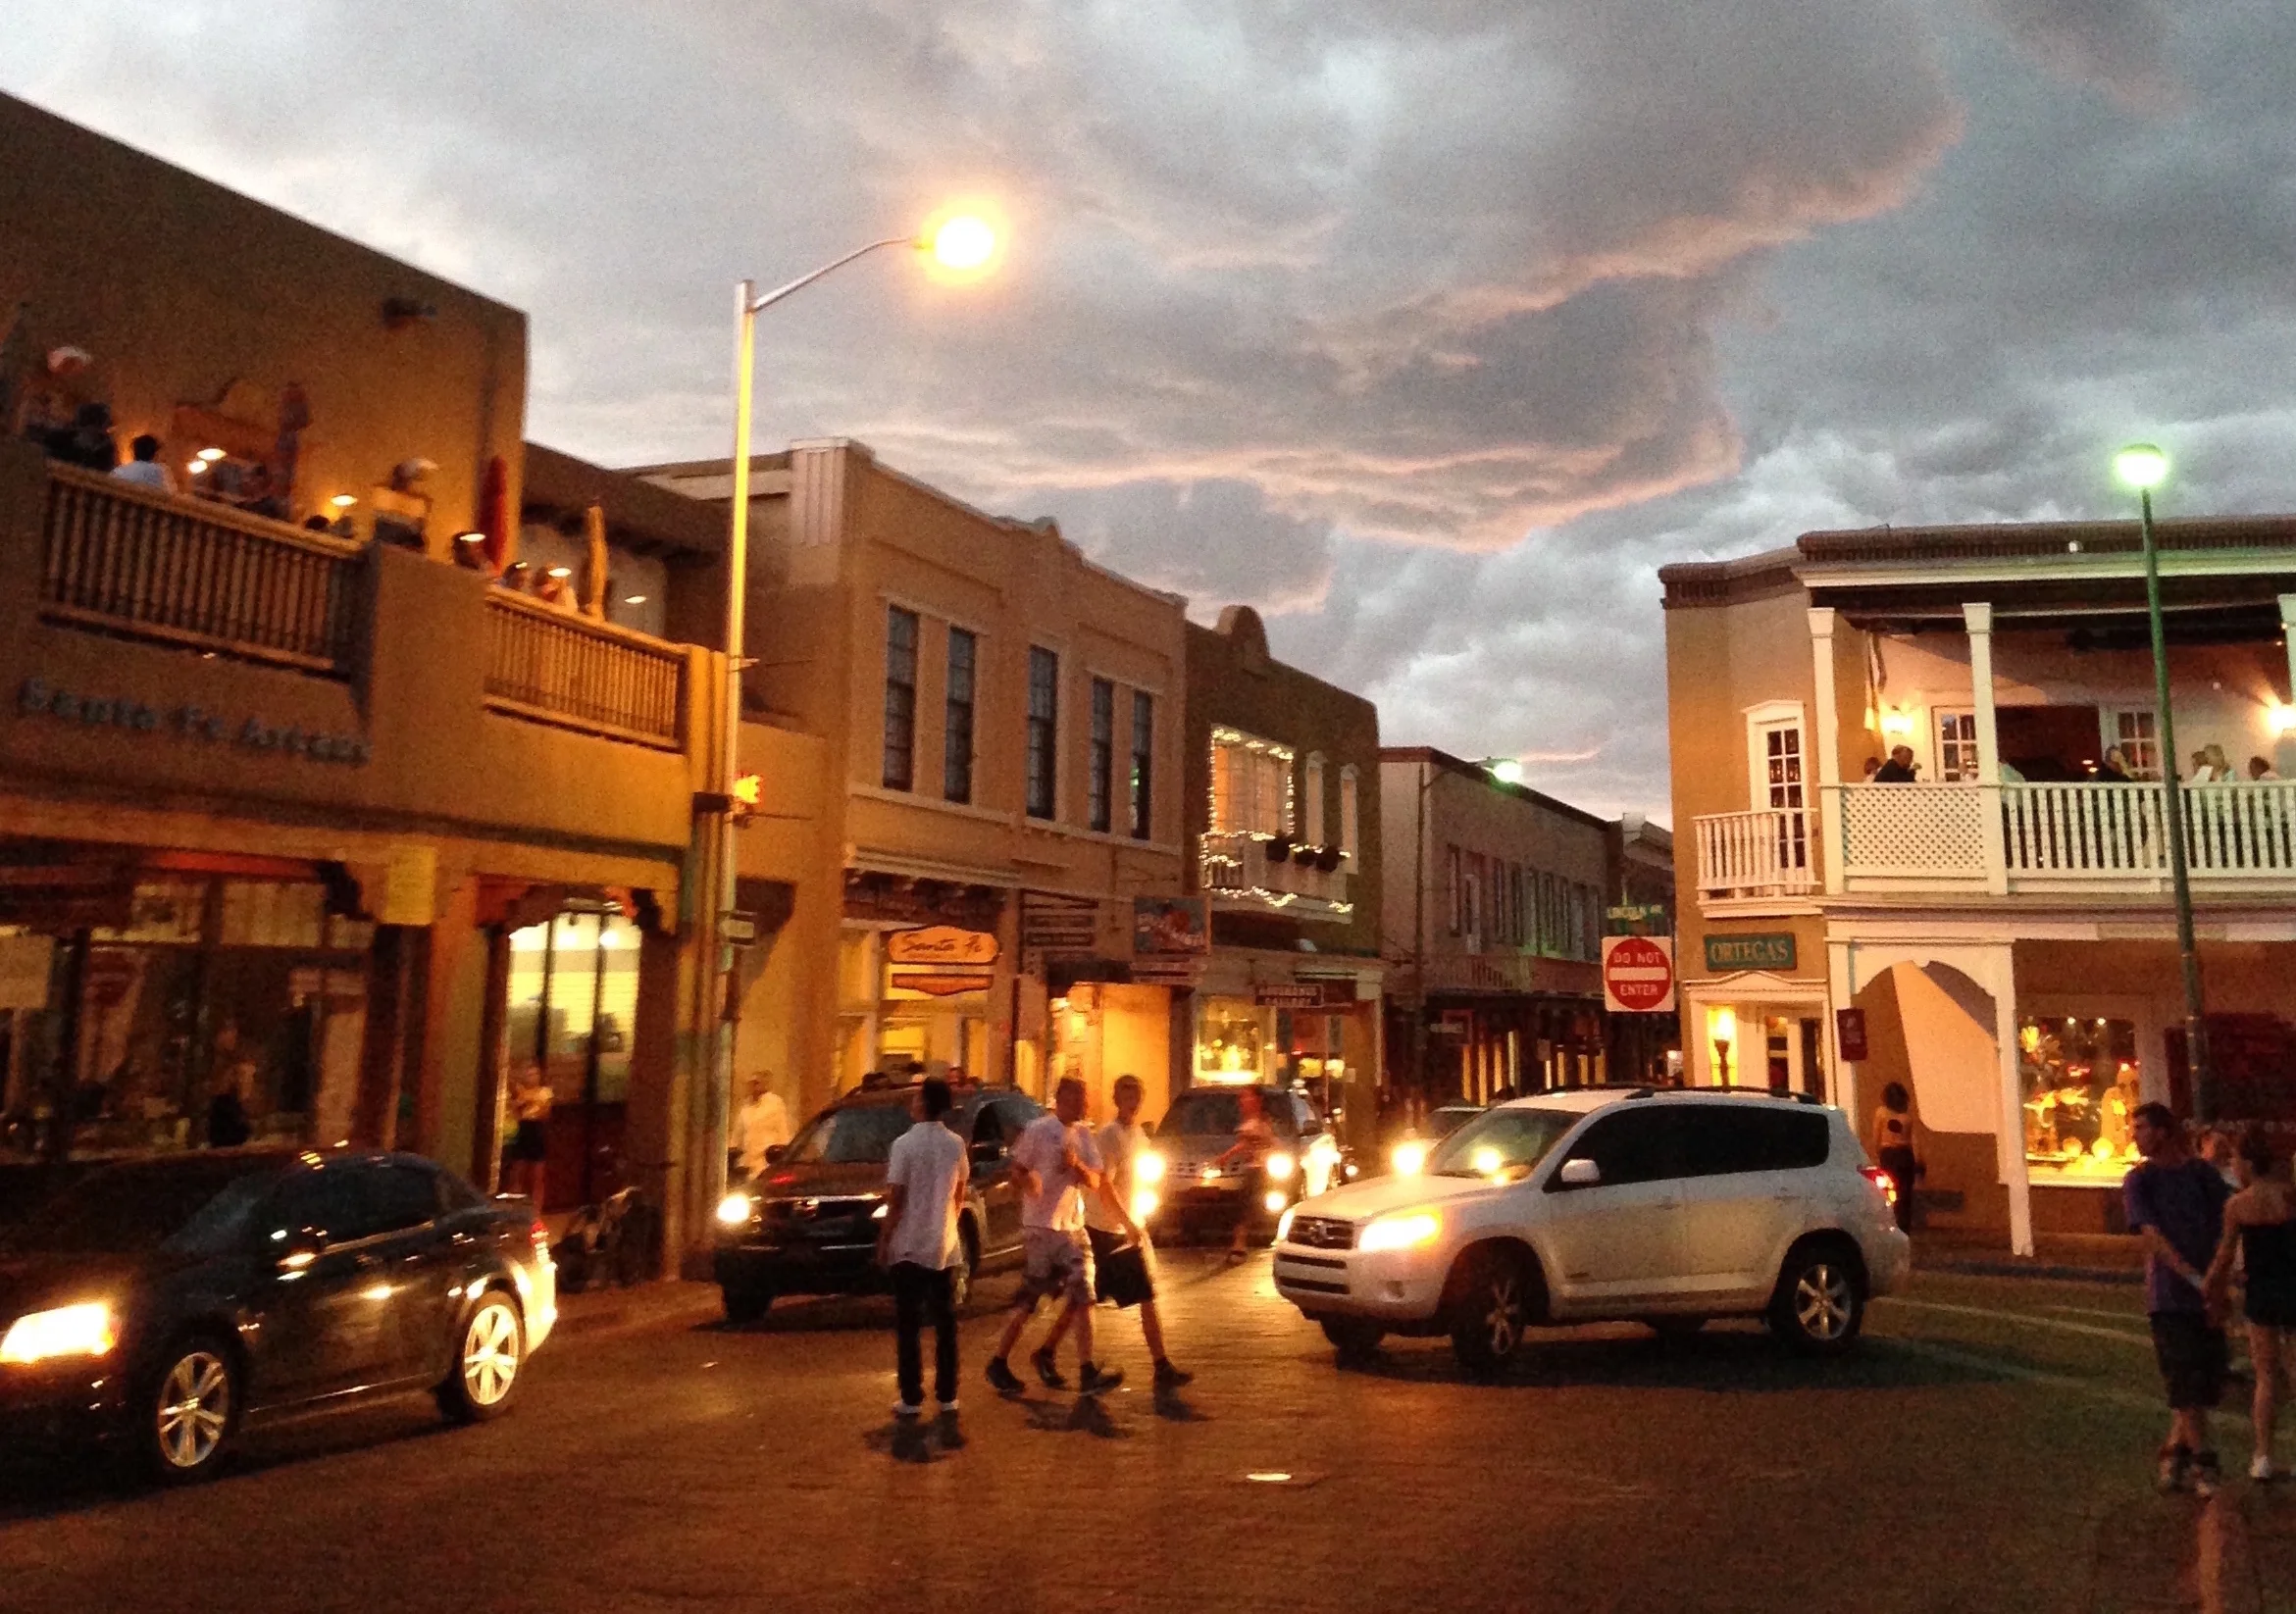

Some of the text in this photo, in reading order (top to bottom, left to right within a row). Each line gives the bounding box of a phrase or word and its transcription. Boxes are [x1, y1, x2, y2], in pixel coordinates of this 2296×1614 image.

[901, 933, 957, 953] Santa
[1613, 952, 1660, 964] DO NOT
[1620, 984, 1658, 996] ENTER
